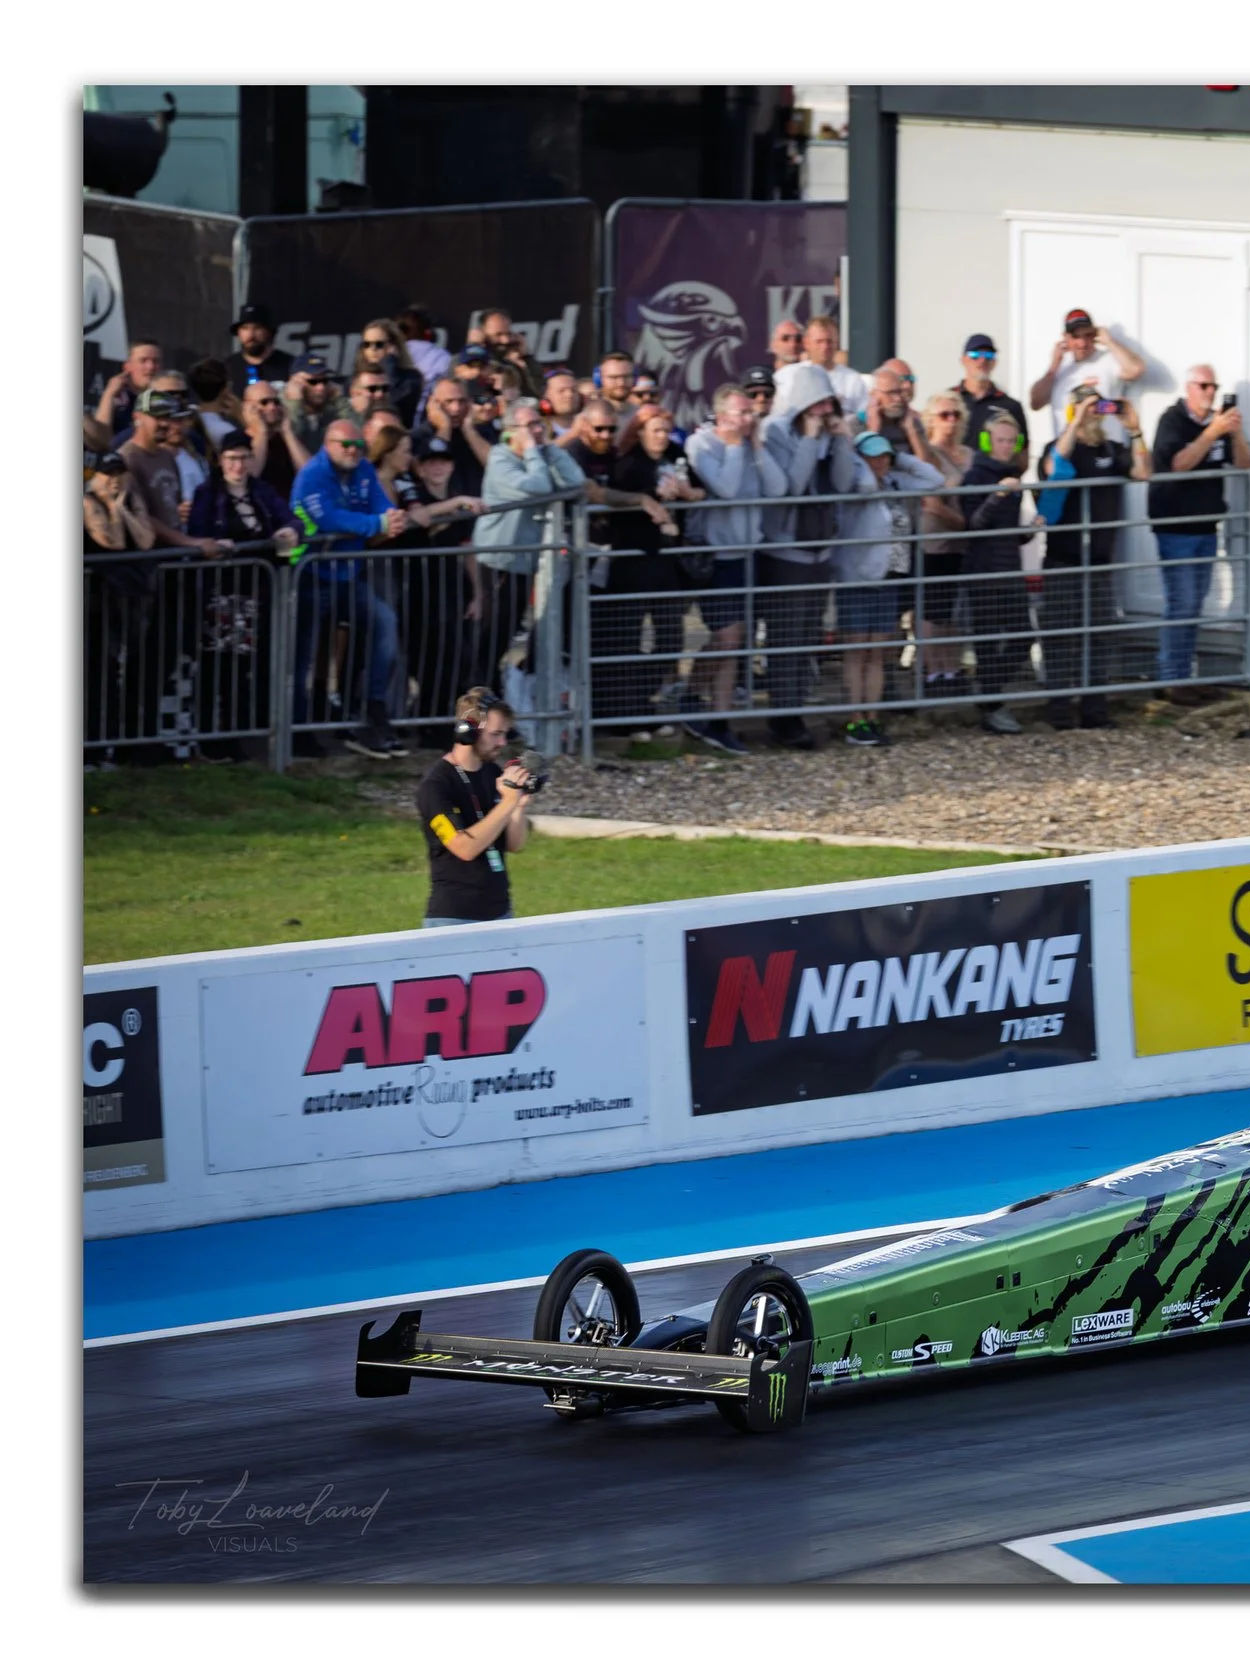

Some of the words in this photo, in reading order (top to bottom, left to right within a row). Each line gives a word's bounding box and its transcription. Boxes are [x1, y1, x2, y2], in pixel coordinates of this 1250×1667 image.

[789, 934, 1082, 1038] NANKANG
[303, 966, 548, 1076] ARP
[1000, 1013, 1065, 1042] TYRES
[302, 1081, 414, 1116] automotive
[471, 1066, 556, 1103] products
[514, 1097, 633, 1121] www.arp-bolts.com
[1161, 1300, 1191, 1314] autobau
